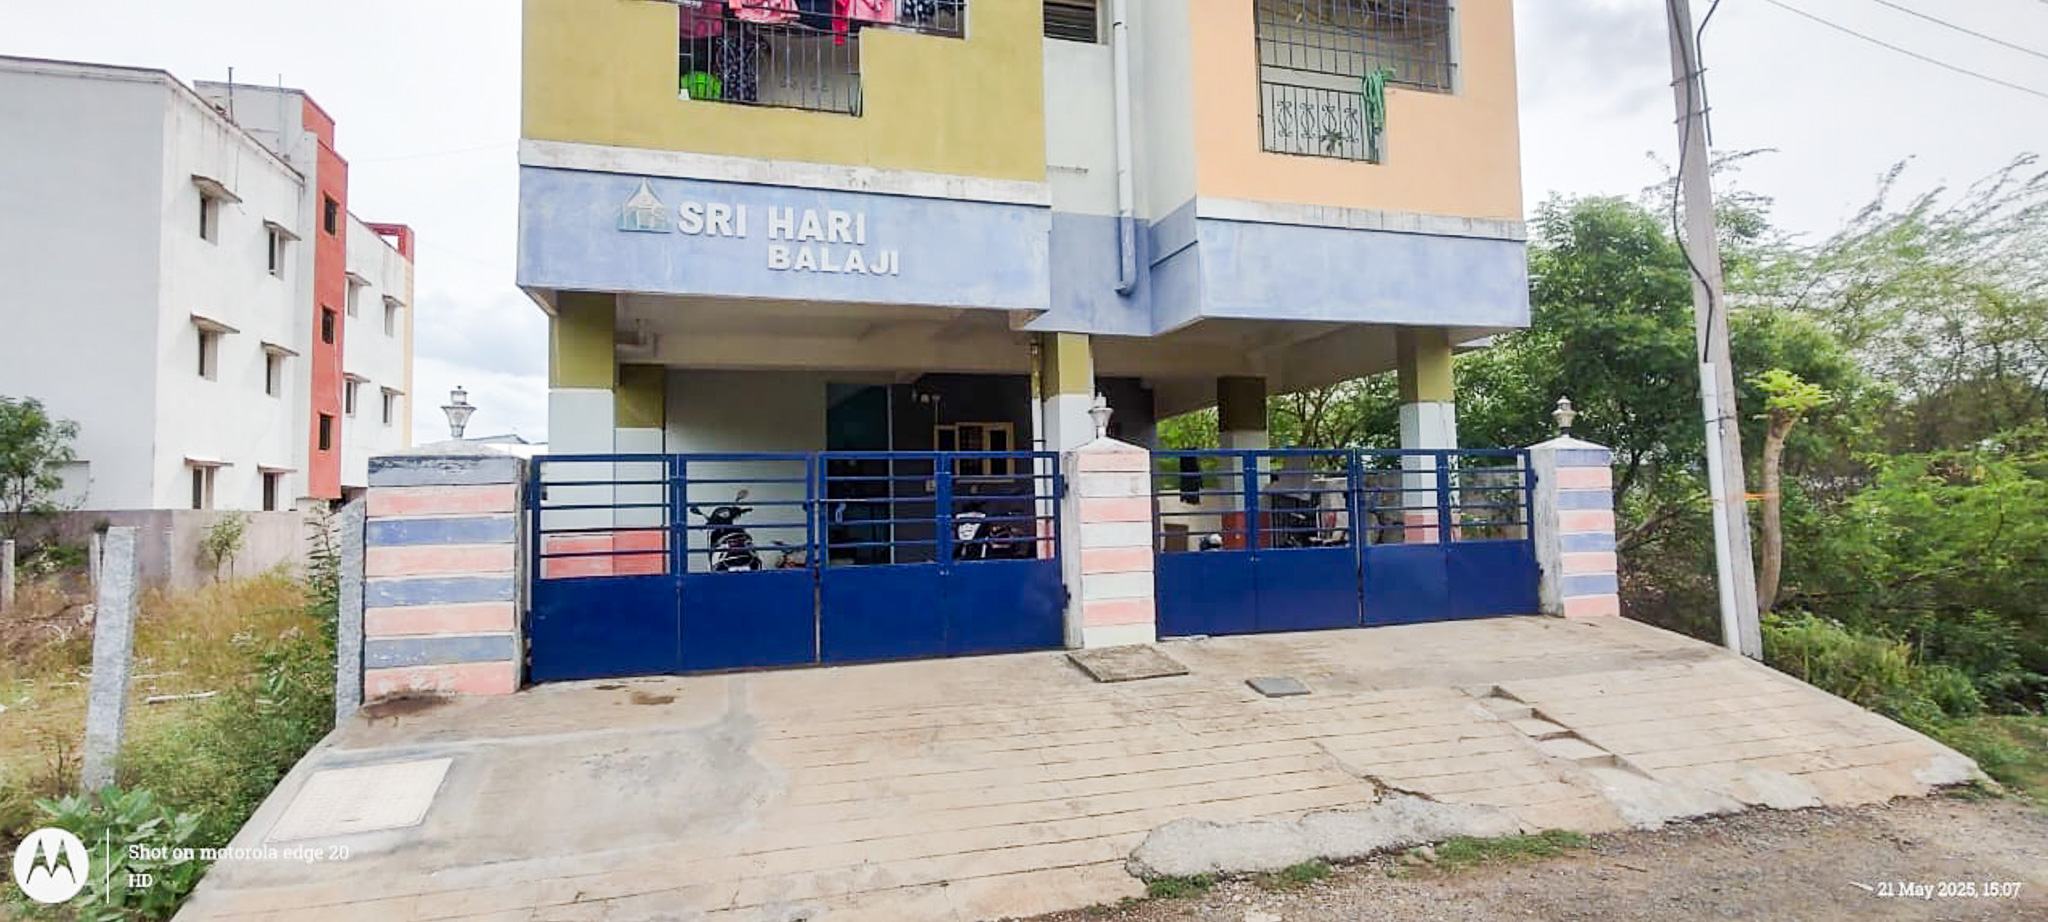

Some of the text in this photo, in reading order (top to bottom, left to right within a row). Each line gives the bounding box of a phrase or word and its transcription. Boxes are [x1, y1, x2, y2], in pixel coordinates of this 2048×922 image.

[677, 201, 866, 244] SRI HARI
[766, 244, 900, 276] BALAJI
